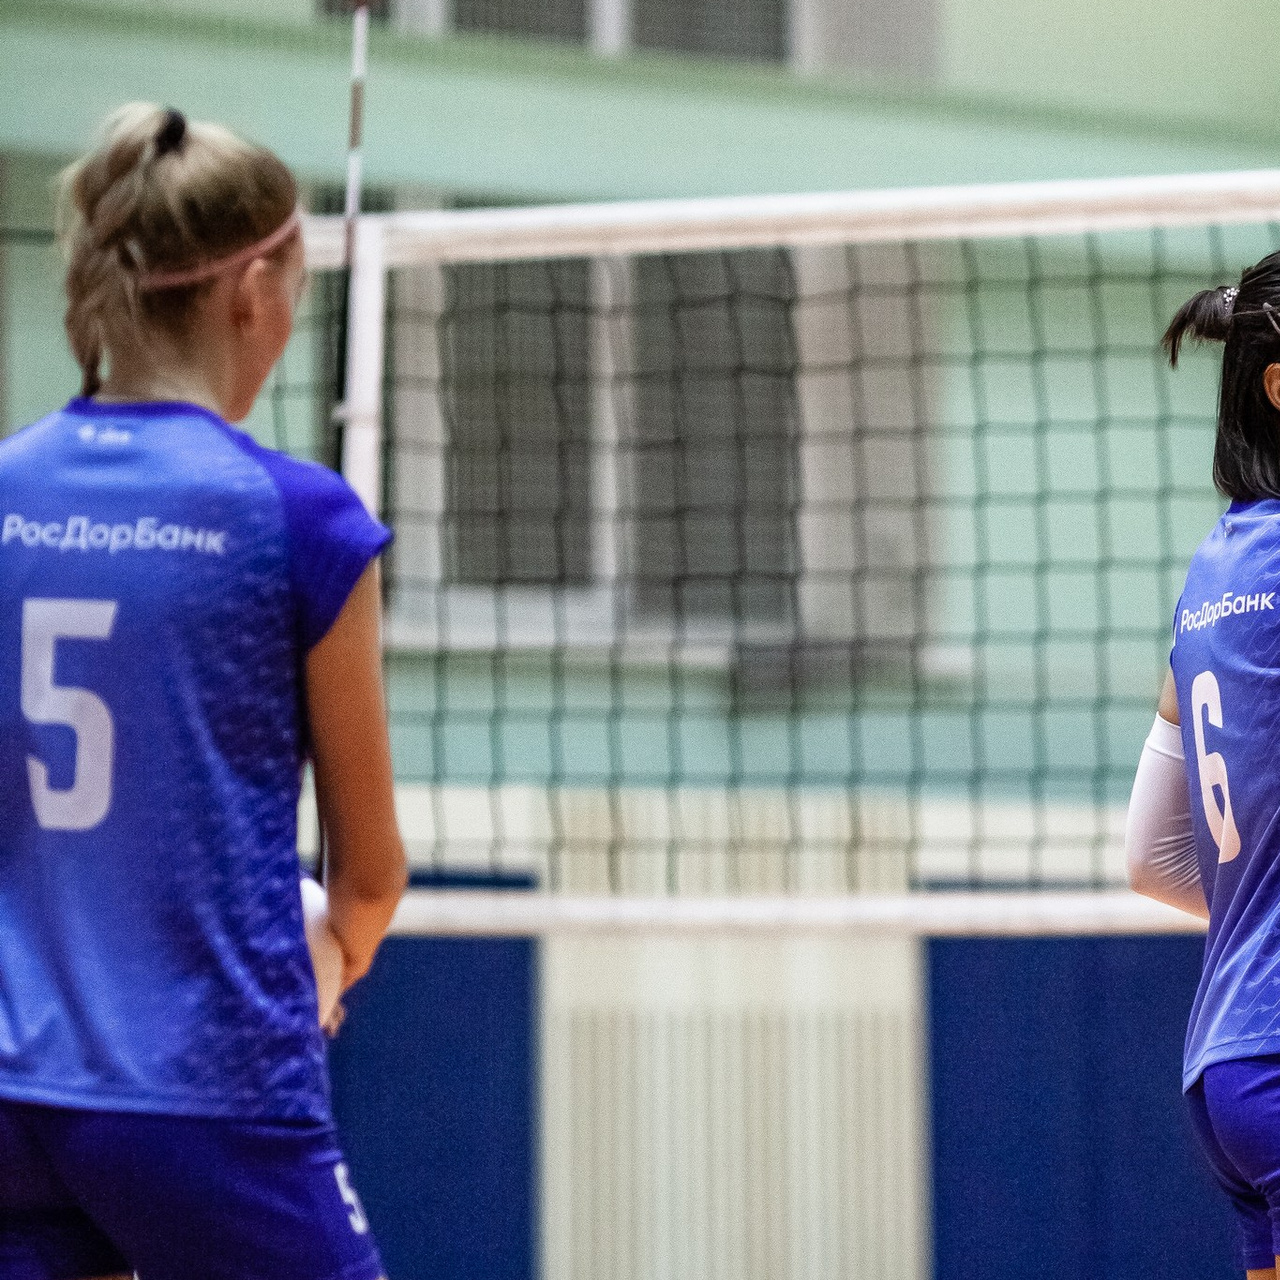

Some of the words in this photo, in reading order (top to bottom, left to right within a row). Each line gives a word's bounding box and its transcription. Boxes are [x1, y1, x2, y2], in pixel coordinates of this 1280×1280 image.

[1, 512, 227, 556] РосДорБанк
[1180, 591, 1276, 634] РосДорБанк
[20, 596, 118, 832] 5
[1190, 670, 1241, 864] 6
